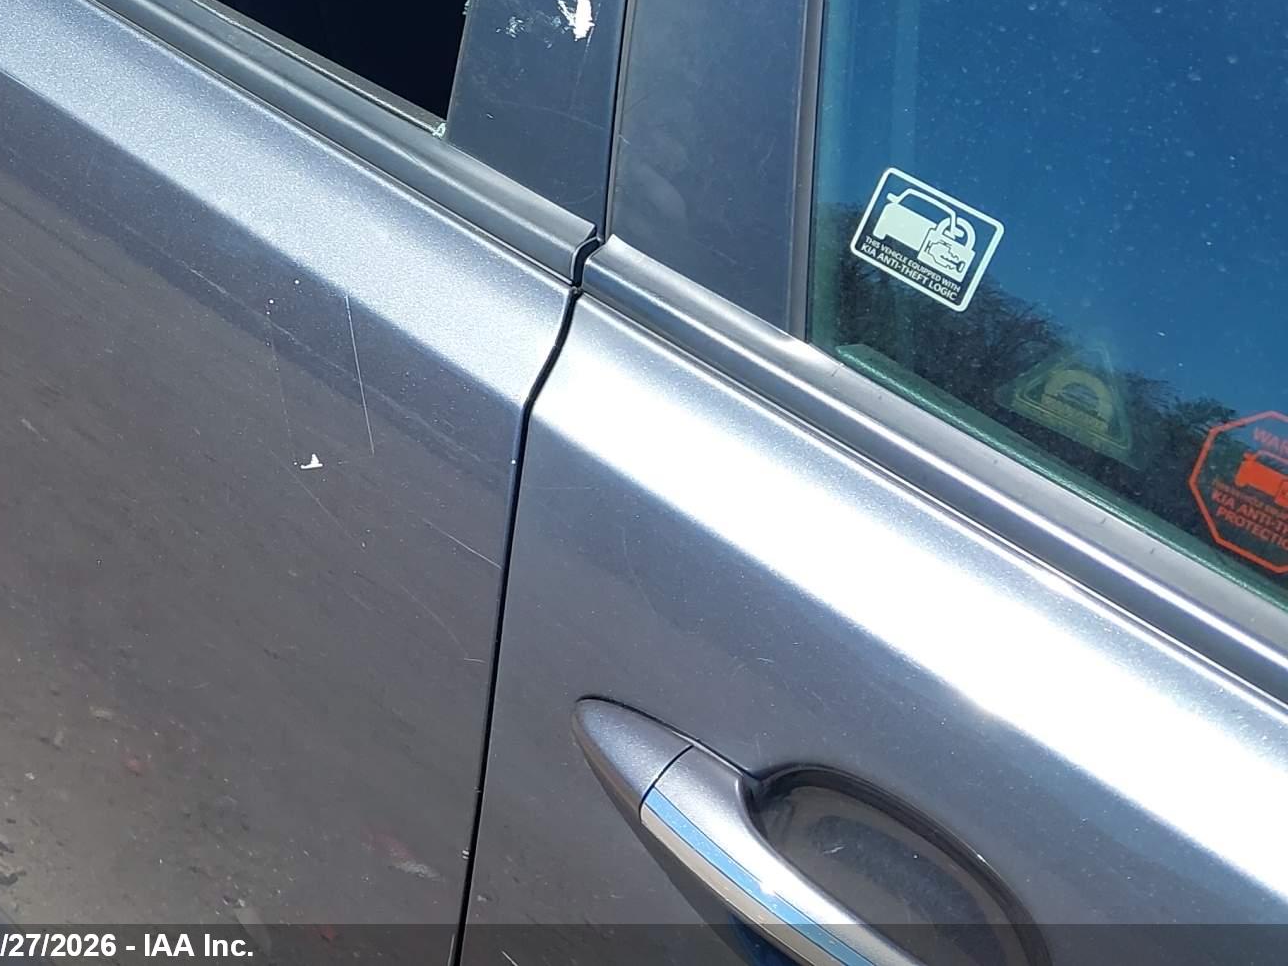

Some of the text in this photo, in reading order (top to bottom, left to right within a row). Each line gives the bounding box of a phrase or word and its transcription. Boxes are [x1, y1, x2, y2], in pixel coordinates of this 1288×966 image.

[860, 242, 958, 301] KIA ANTI-THEFT LOGIC
[865, 235, 961, 293] THIS VEHICLE EQUIPPED WITH
